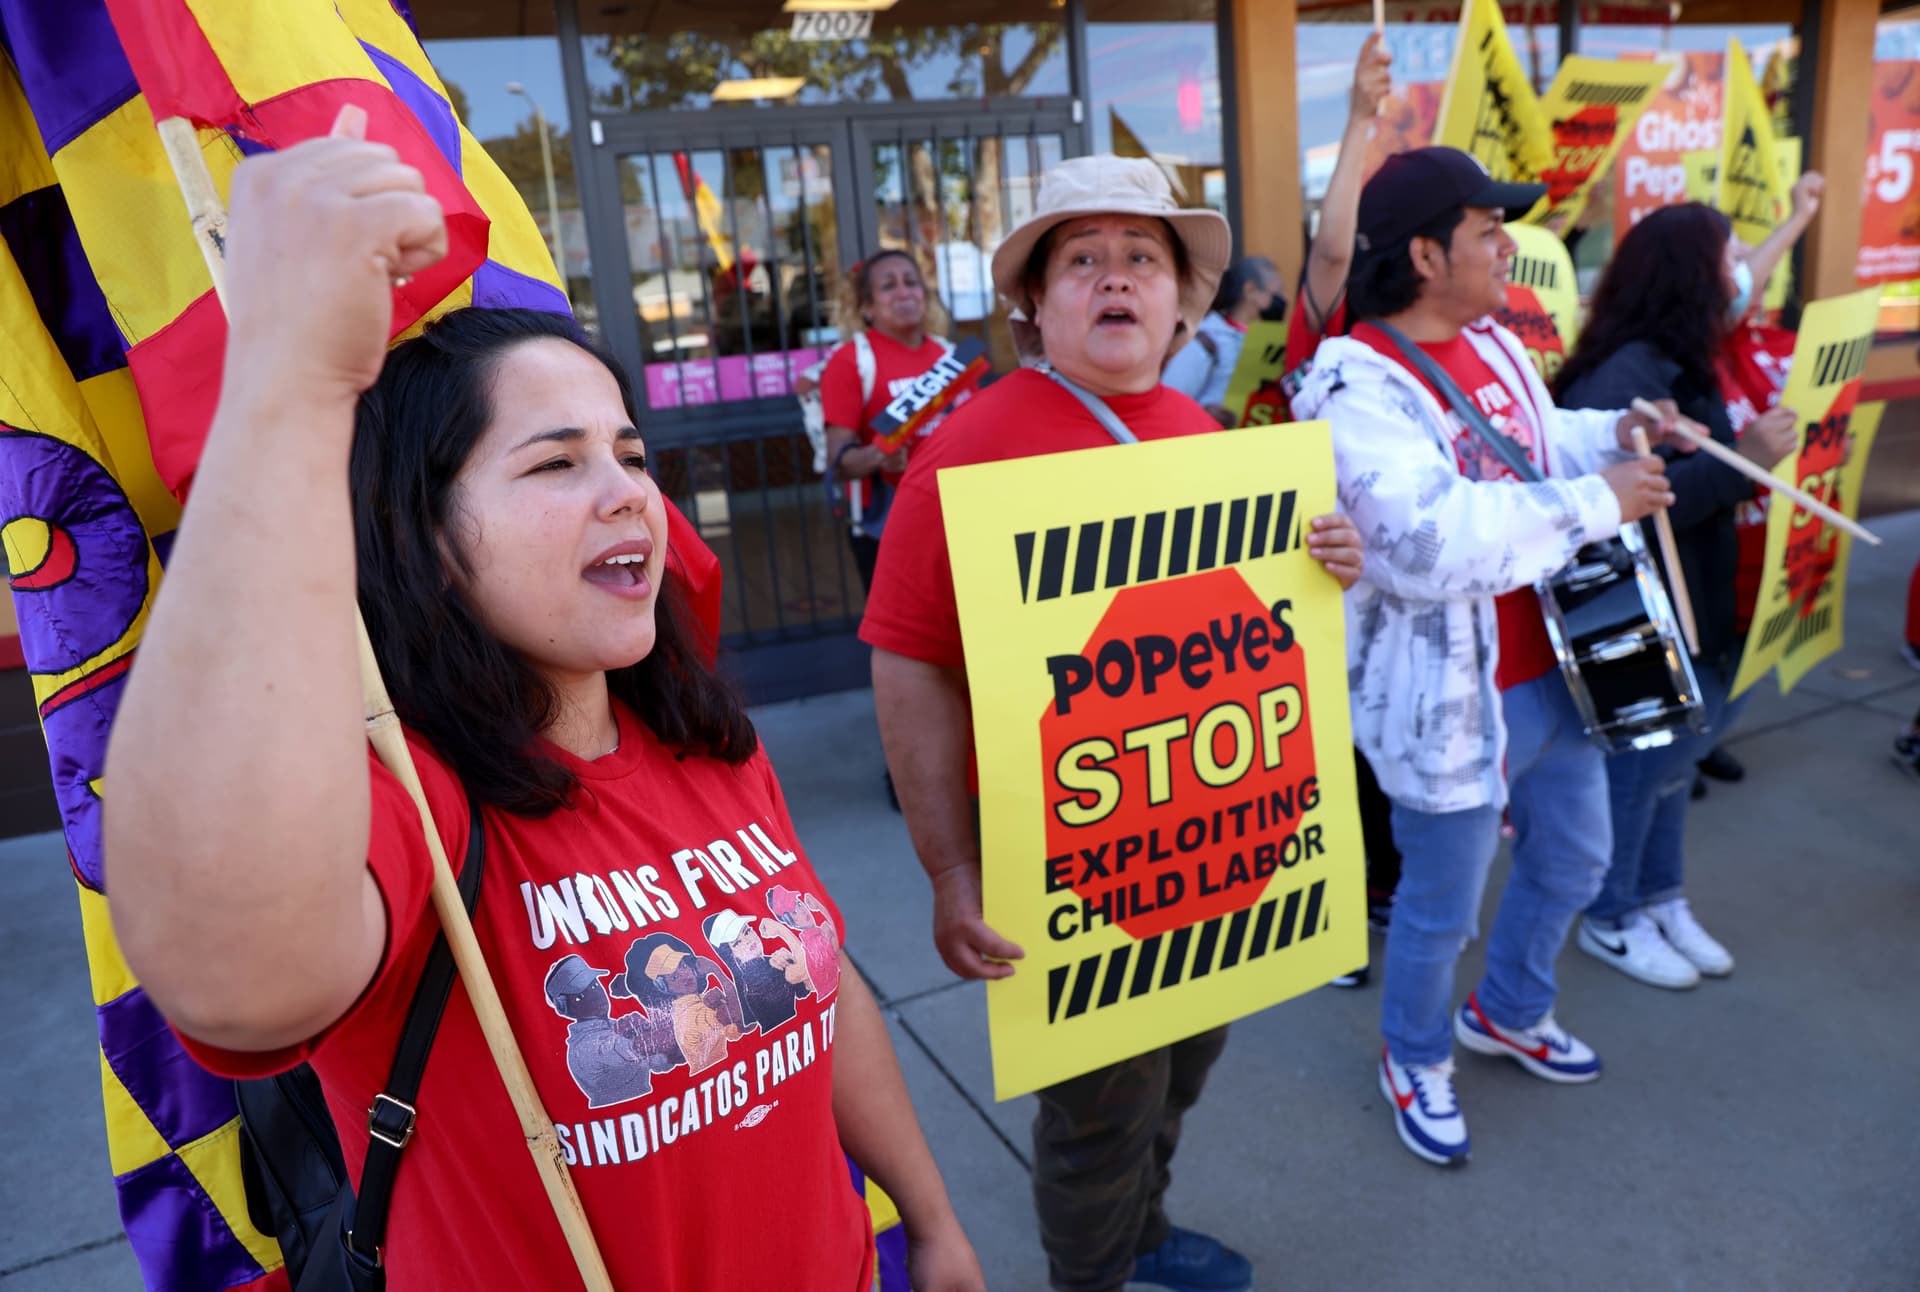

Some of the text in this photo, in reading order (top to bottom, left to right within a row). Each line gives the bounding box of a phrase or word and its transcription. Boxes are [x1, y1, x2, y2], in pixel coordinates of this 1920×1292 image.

[797, 11, 870, 40] 7007
[1624, 156, 1686, 205] Pep
[885, 346, 967, 423] FIGHT
[1053, 683, 1304, 829] STOP
[670, 838, 761, 909] FOR
[735, 822, 798, 876] AL
[1045, 776, 1320, 894] EXPLOITING
[1047, 824, 1326, 942] CHILD LABOR
[555, 1060, 748, 1168] SINDICATOS
[755, 1020, 816, 1096] PARA
[819, 1000, 837, 1053] TO
